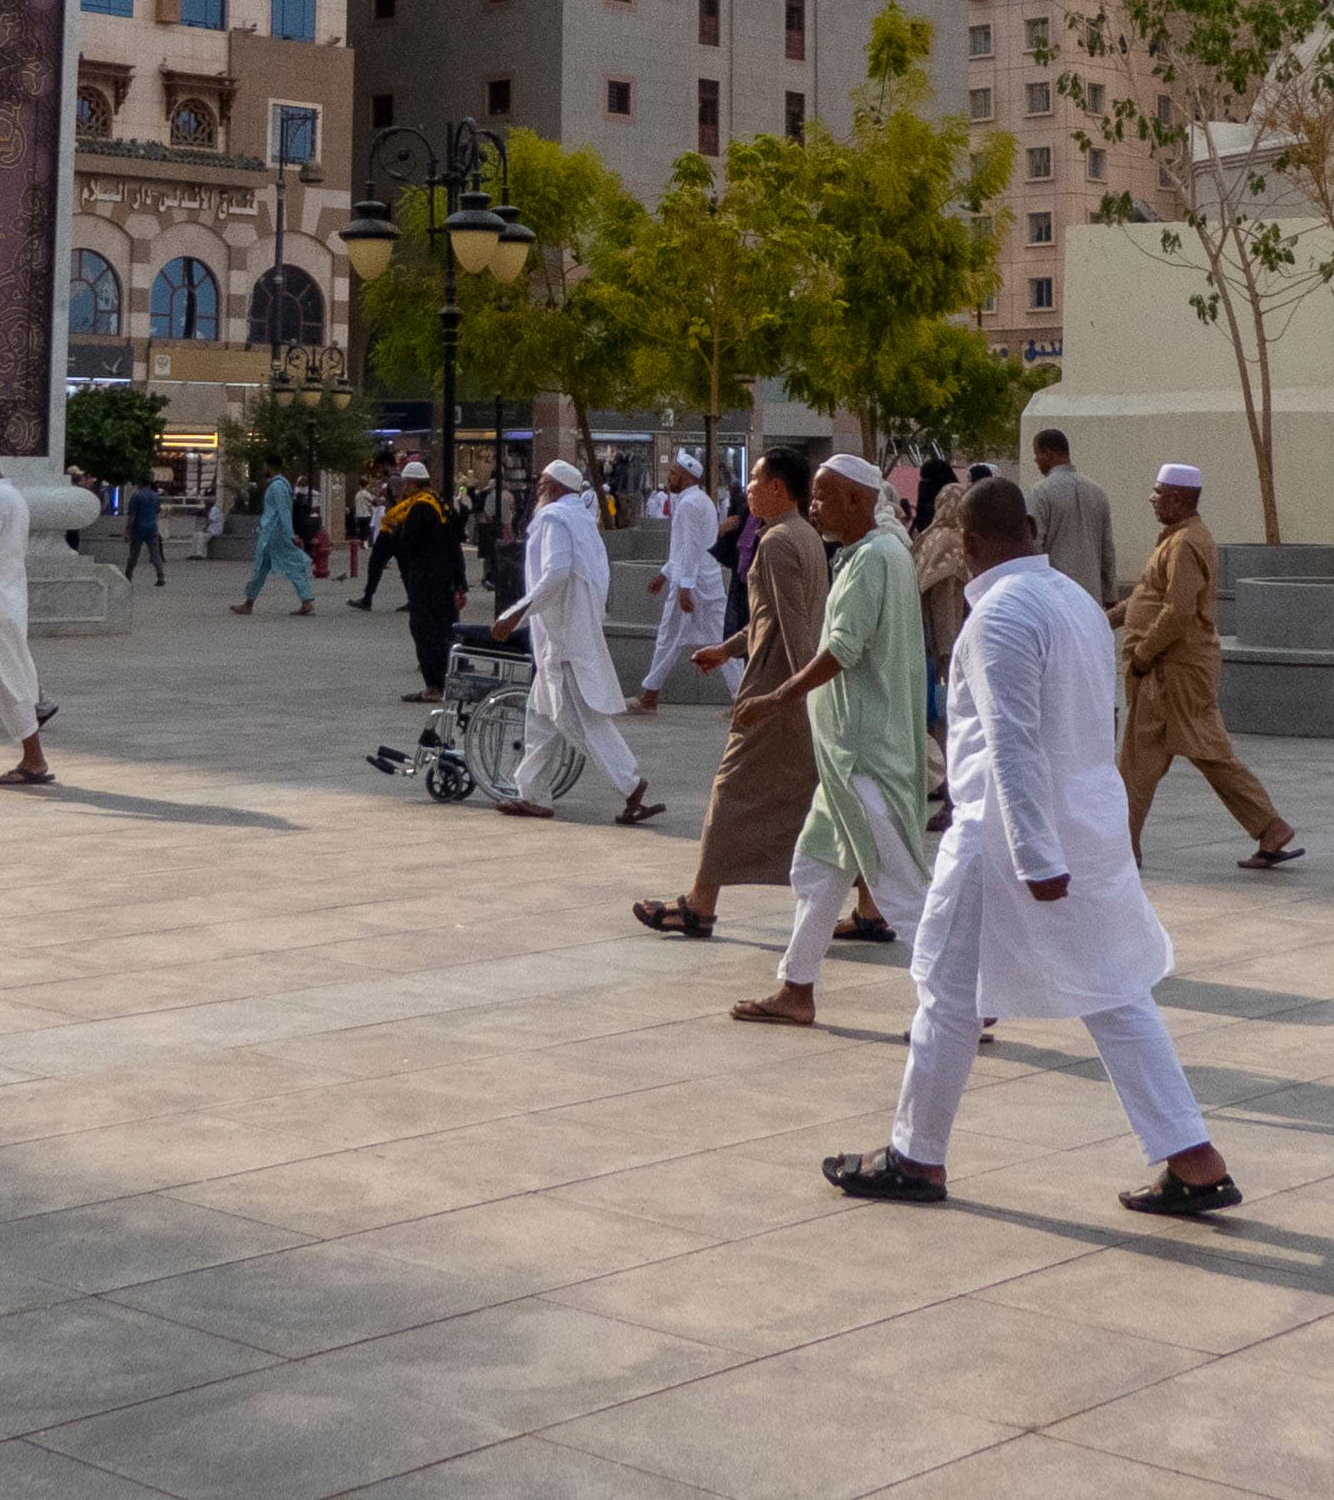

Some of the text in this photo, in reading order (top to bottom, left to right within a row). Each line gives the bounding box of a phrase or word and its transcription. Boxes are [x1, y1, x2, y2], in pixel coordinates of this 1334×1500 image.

[81, 179, 129, 206] السلام
[132, 186, 152, 210] دار
[218, 187, 259, 219] فندق
